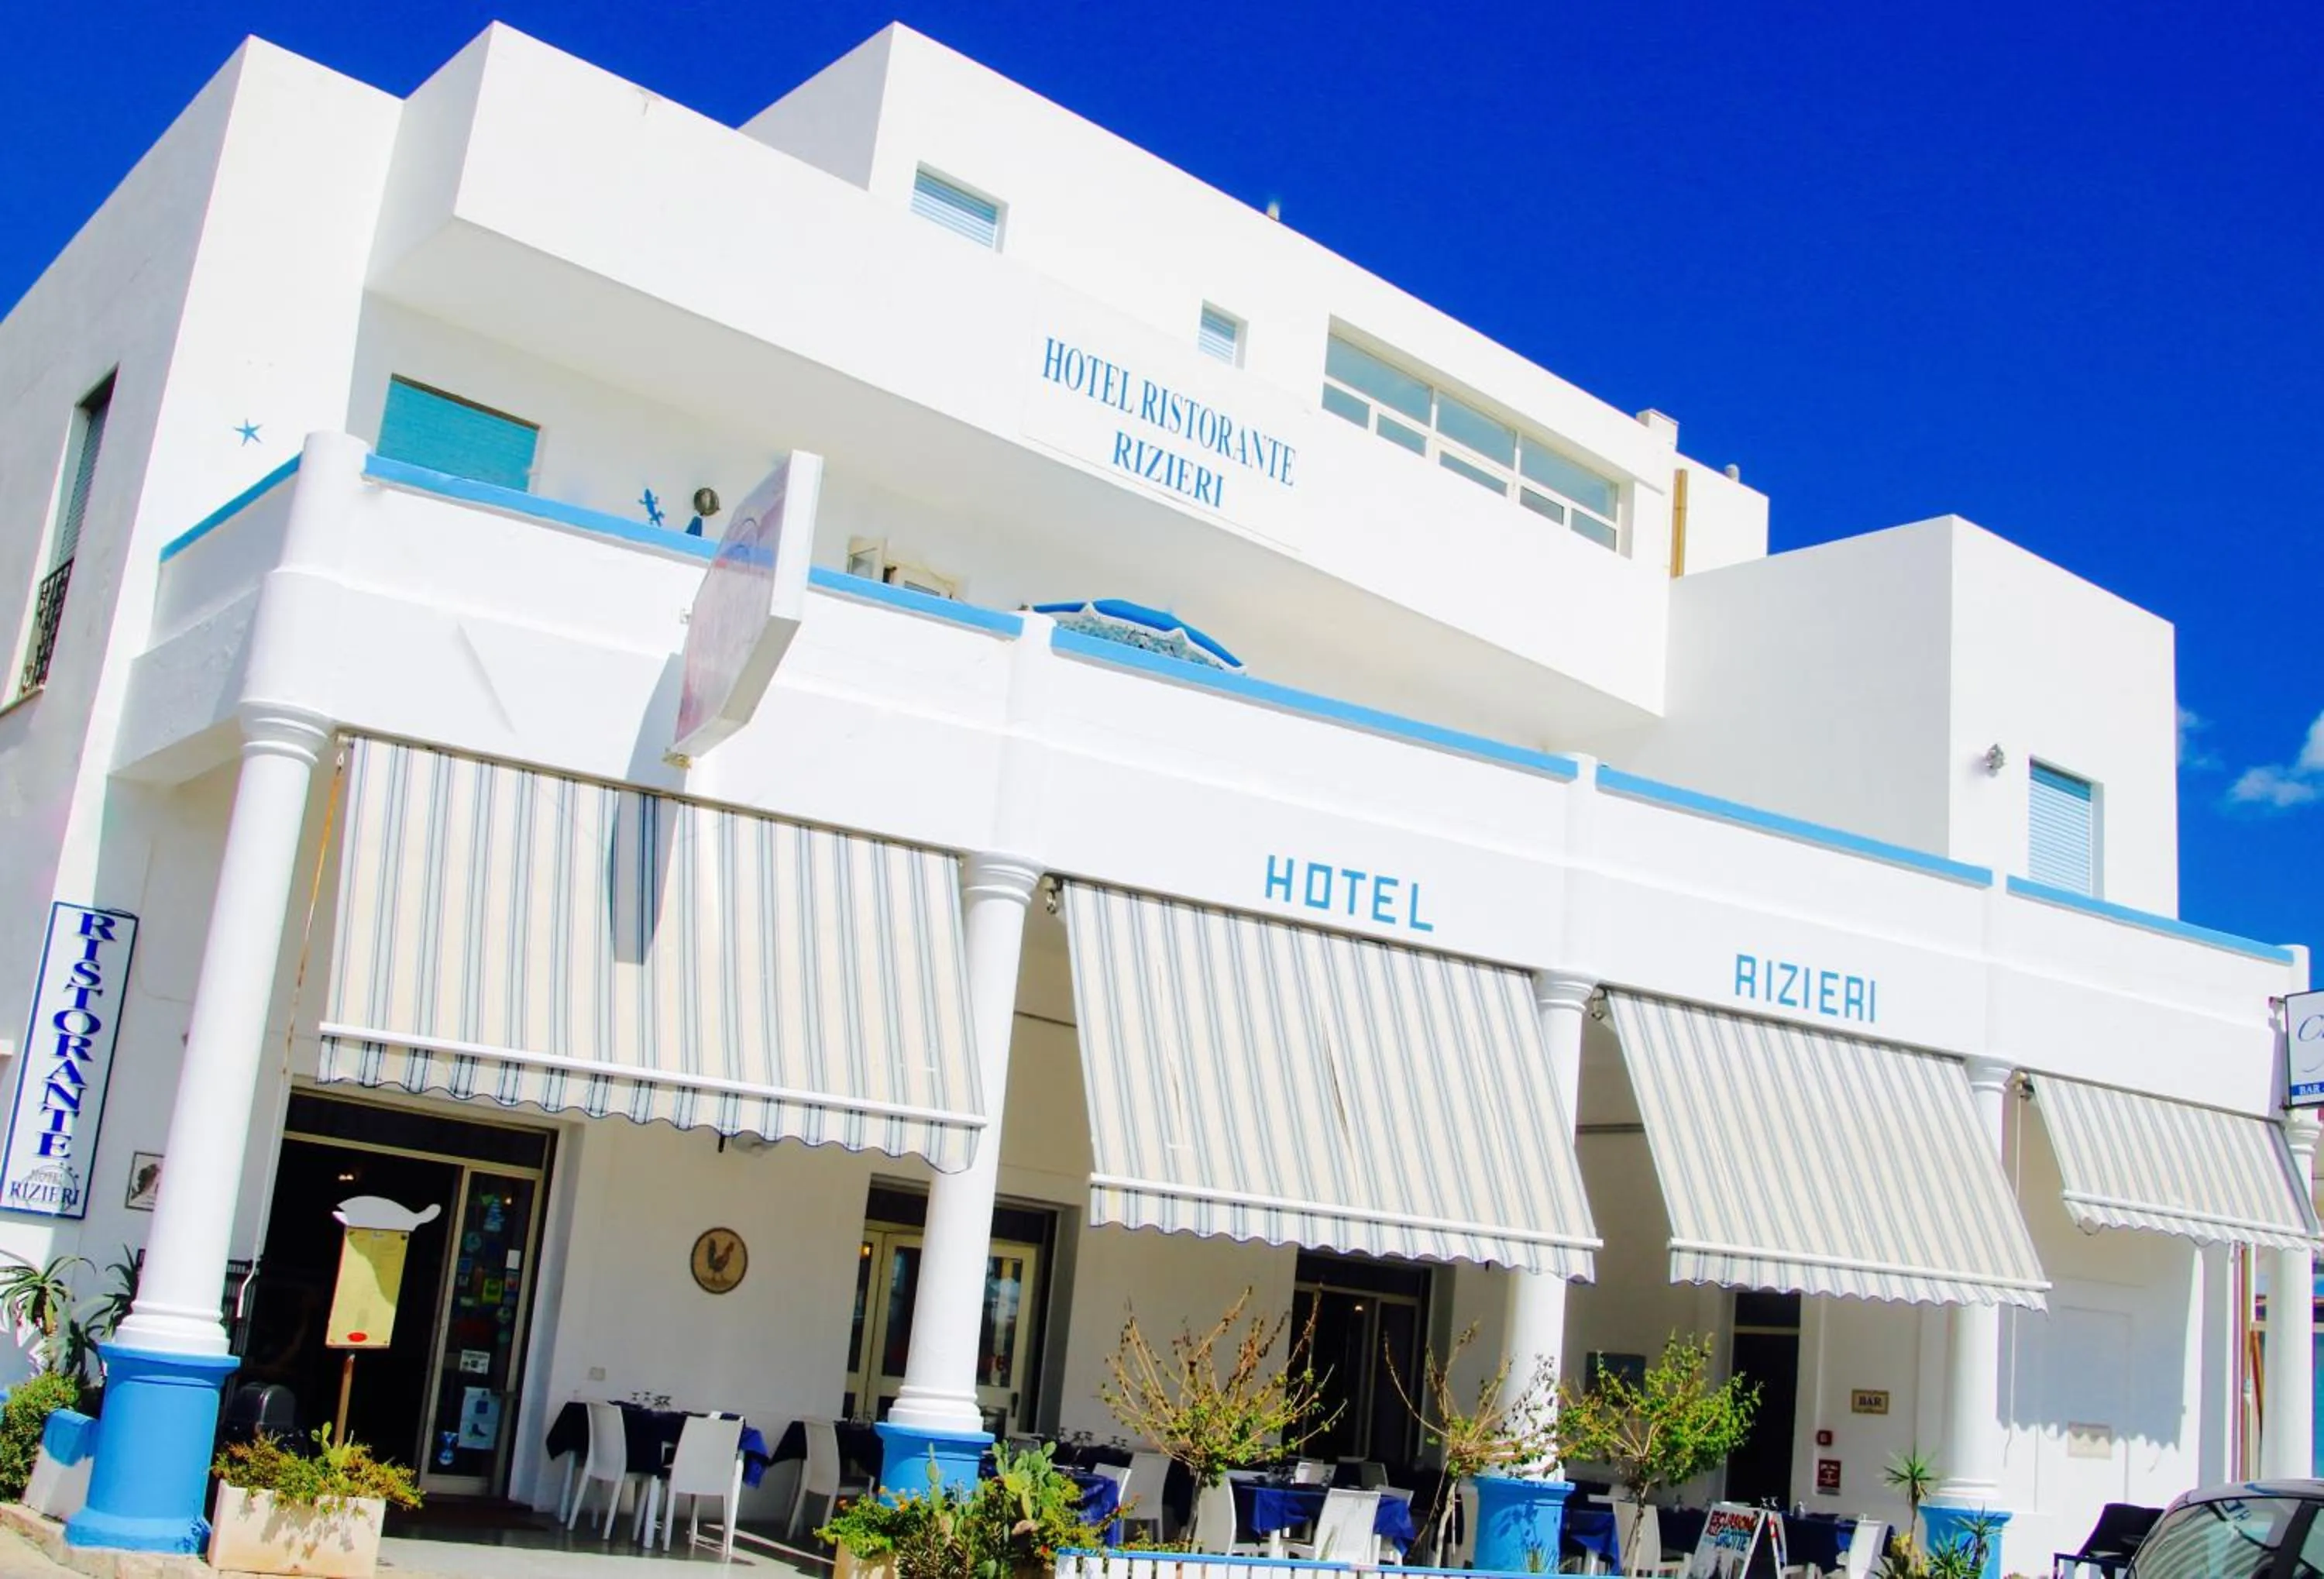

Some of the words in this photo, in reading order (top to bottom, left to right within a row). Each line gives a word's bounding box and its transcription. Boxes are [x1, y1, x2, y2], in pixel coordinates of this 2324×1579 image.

[1042, 336, 1133, 415] HOTEL
[1140, 380, 1296, 487] RISTORANTE
[1112, 430, 1224, 508] RIZIERI
[1265, 855, 1433, 932] HOTEL
[1735, 954, 1875, 1023] RIZIERI
[36, 912, 116, 1159] RISTORANTE
[2298, 1084, 2320, 1096] BAR
[10, 1181, 80, 1206] RIZIERI
[1858, 1395, 1882, 1407] BAR
